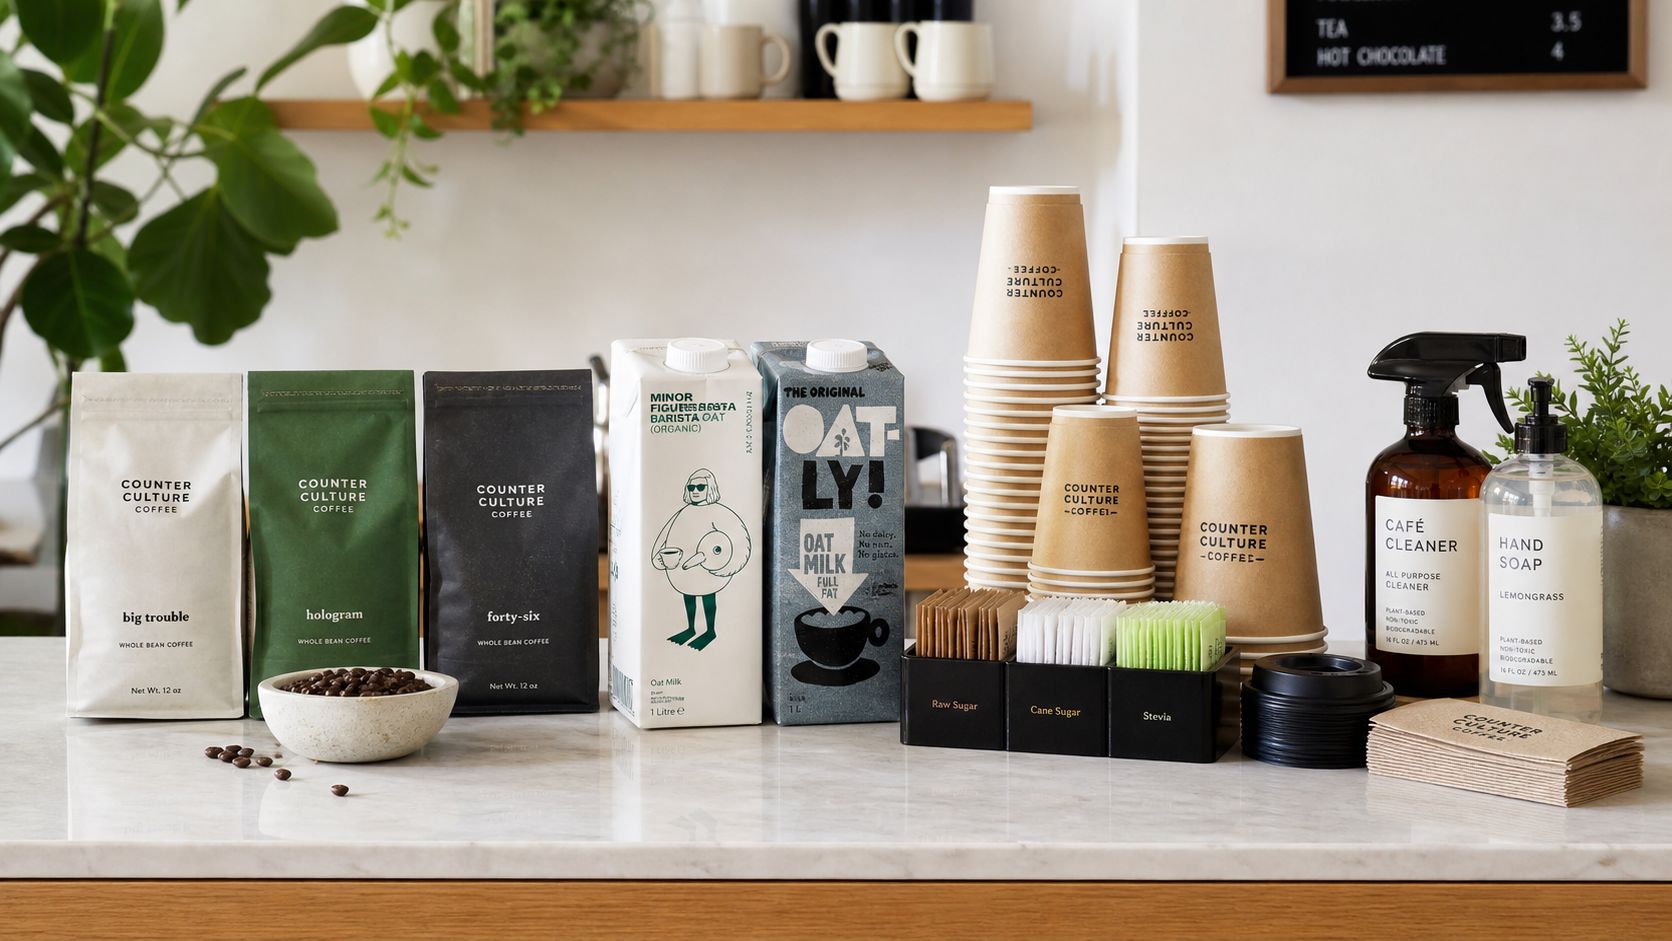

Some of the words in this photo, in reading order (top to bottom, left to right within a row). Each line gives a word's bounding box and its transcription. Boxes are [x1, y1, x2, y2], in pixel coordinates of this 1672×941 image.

[1551, 11, 1582, 32] 3.5
[1316, 18, 1349, 38] TEA
[1317, 47, 1350, 67] HOT
[1356, 45, 1447, 66] CHOCOLATE
[1551, 40, 1564, 62] 4
[1006, 278, 1062, 286] CULTURE
[1006, 289, 1063, 298] COUNTER
[1137, 322, 1192, 330] CULTURE
[1136, 333, 1194, 342] COUNTER
[650, 393, 693, 402] MINOR
[784, 387, 808, 398] THE
[810, 387, 865, 398] ORIGINAL
[650, 414, 699, 423] BARISTA
[702, 413, 725, 422] OAT
[650, 424, 701, 434] (ORGANIC)
[121, 480, 191, 490] COUNTER
[298, 478, 367, 489] COUNTER
[476, 484, 545, 494] COUNTER
[802, 460, 885, 510] LY!
[1064, 483, 1120, 494] COUNTER
[122, 492, 190, 502] CULTURE
[300, 492, 366, 502] CULTURE
[478, 496, 544, 507] CULTURE
[1064, 494, 1119, 505] CULTURE
[134, 506, 177, 514] COFFEE
[491, 510, 533, 518] COFFEE
[1200, 522, 1268, 536] COUNTER
[1386, 518, 1424, 533] CAFÉ
[859, 530, 870, 538] No
[804, 533, 834, 553] OAT
[1200, 536, 1266, 549] CULTURE
[1386, 538, 1458, 552] CLEANER
[1500, 536, 1544, 552] HAND
[804, 554, 846, 575] MILK
[1500, 556, 1542, 571] SOAP
[1386, 570, 1400, 578] ALL
[1401, 572, 1441, 580] PURPOSE
[817, 576, 839, 587] FULL
[1386, 581, 1429, 591] CLEANER
[821, 588, 838, 599] FAT
[1500, 592, 1564, 601] LEMONGRASS
[123, 612, 142, 626] big
[145, 611, 189, 622] trouble
[306, 608, 363, 623] hologram
[487, 610, 541, 624] forty-six
[1500, 636, 1543, 645] PLANT-BASED
[651, 679, 664, 687] Oat
[665, 678, 682, 686] Milk
[163, 686, 171, 694] 12
[656, 707, 675, 716] Litre
[932, 700, 951, 709] Raw
[953, 700, 977, 712] Sugar
[1030, 705, 1053, 716] Cane
[1055, 707, 1081, 718] Sugar
[1143, 711, 1172, 722] Stevia
[1453, 719, 1531, 739] CULTURE
[1464, 714, 1543, 735] COUNTER
[1452, 727, 1506, 741] COFFEE
